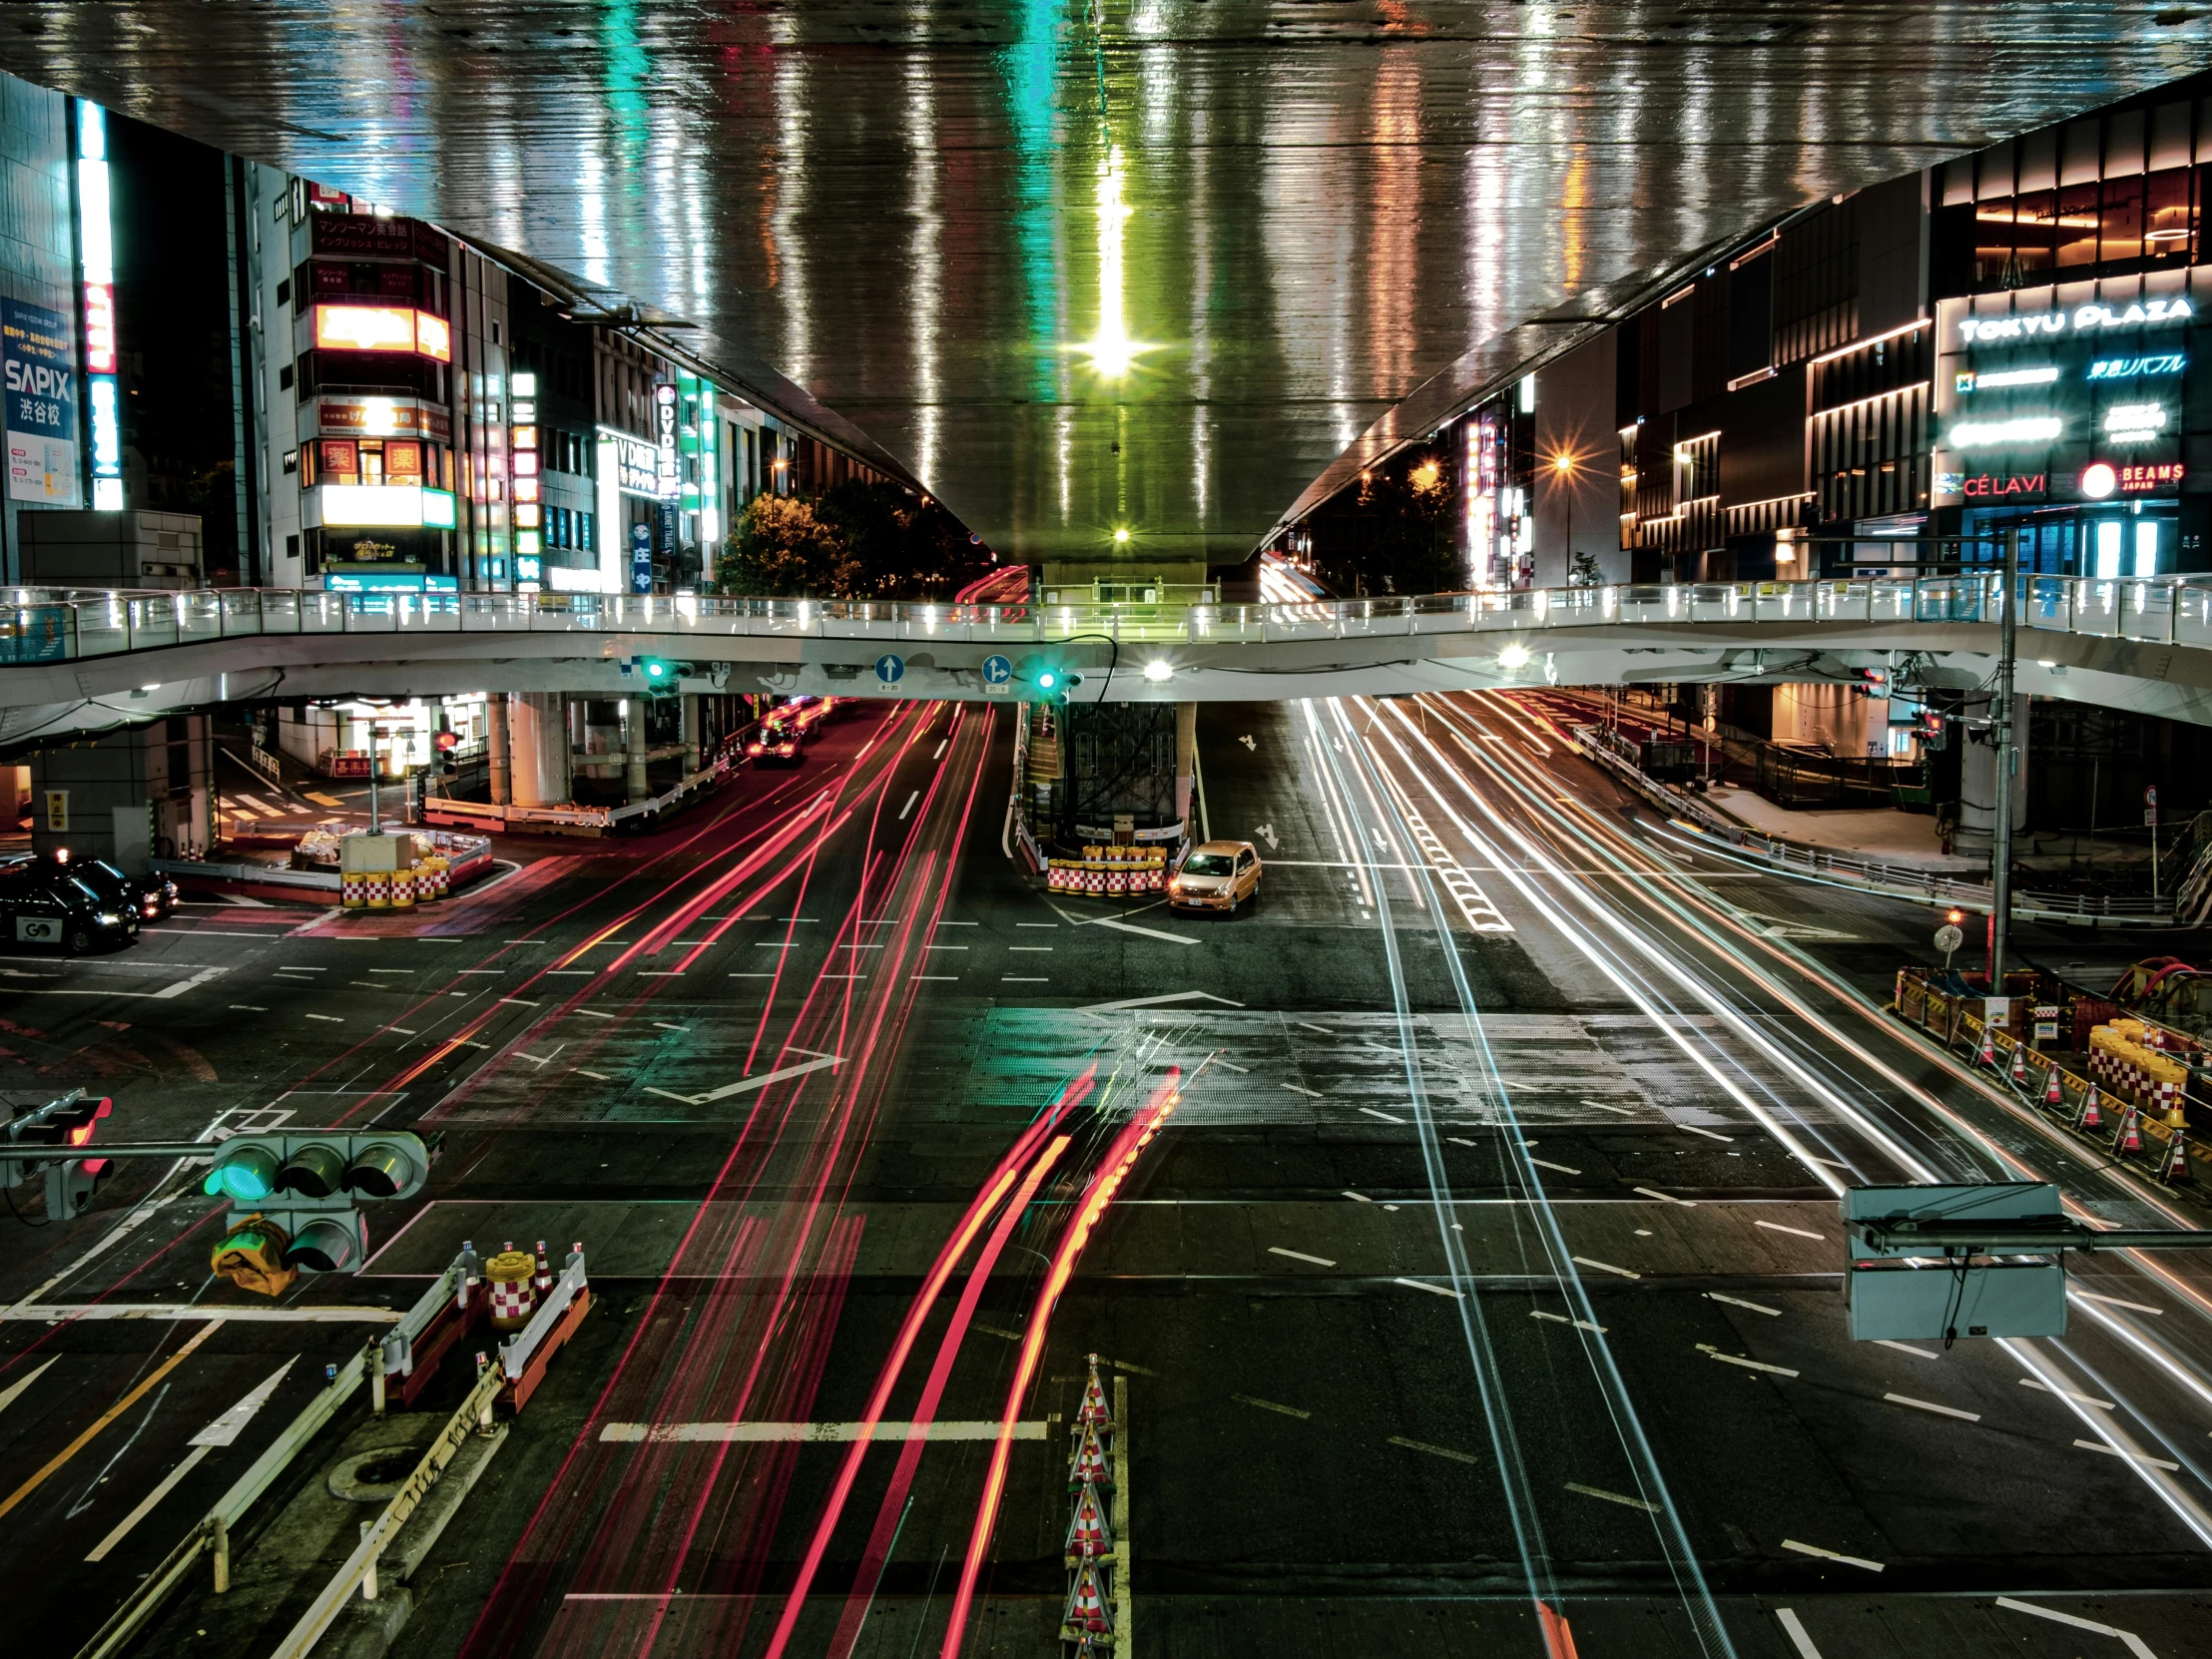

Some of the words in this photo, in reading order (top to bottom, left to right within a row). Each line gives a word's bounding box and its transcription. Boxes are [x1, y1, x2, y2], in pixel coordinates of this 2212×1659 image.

[1958, 312, 2065, 342] TOKYU
[2073, 299, 2193, 329] PLAZA
[5, 358, 71, 402] SAPIX
[20, 397, 61, 427] 渋谷校
[328, 446, 350, 467] 薬
[392, 448, 415, 469] 薬
[2122, 464, 2184, 481] BEAMS
[2122, 481, 2155, 491] JAPAN
[634, 547, 651, 590] 庄や
[25, 922, 52, 938] GO
